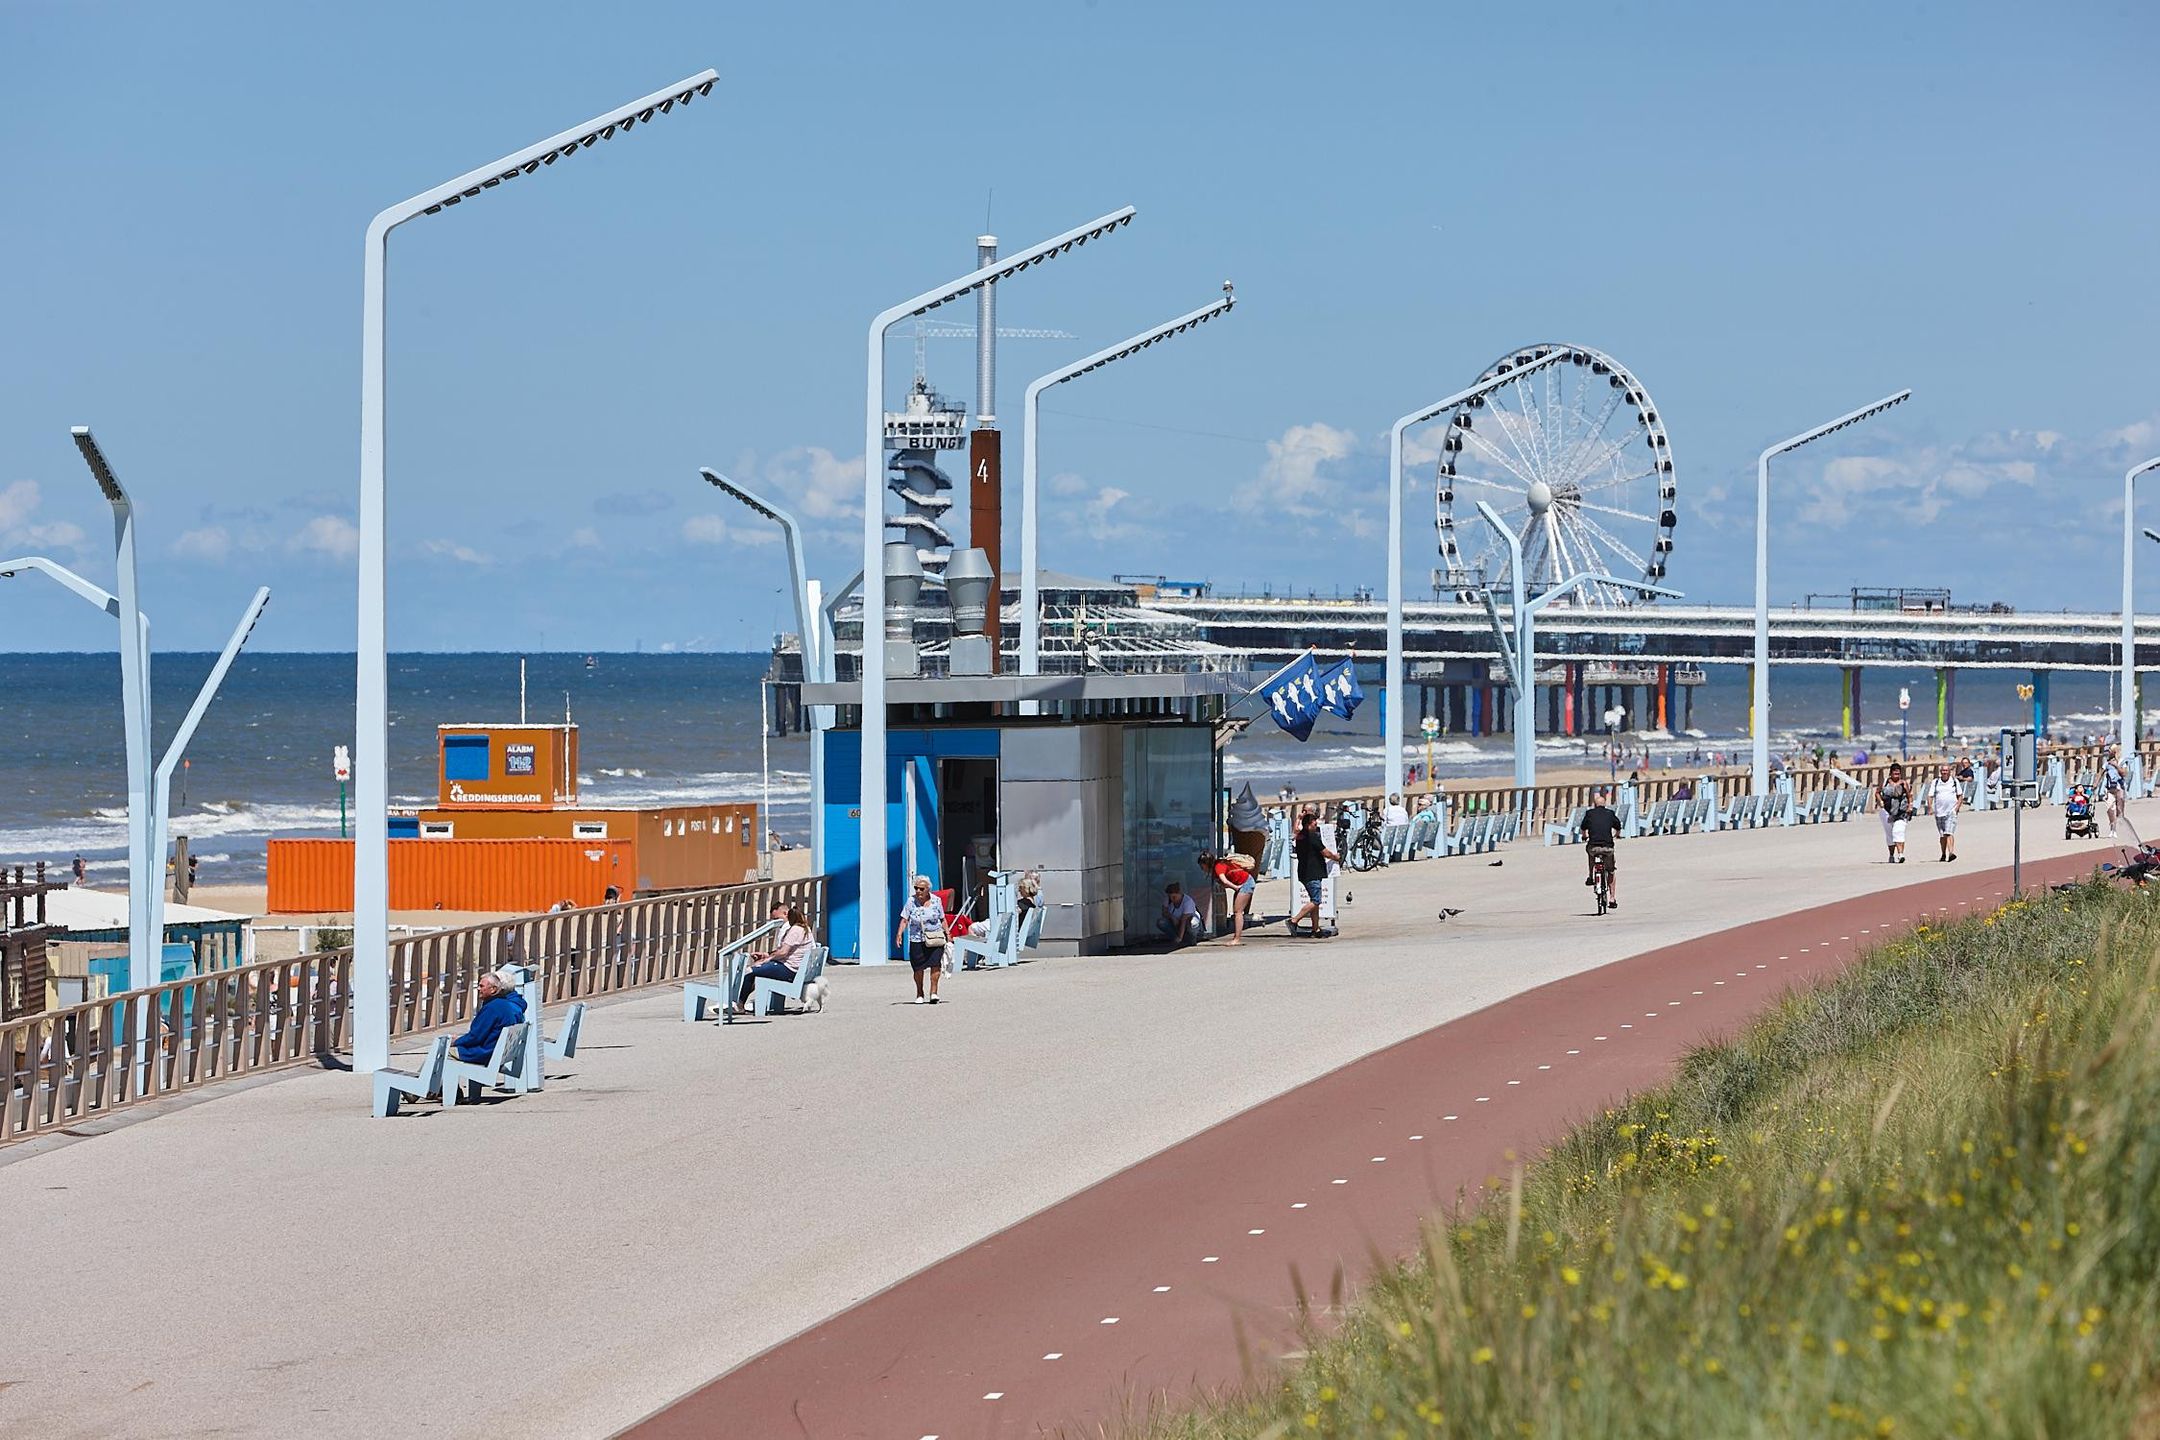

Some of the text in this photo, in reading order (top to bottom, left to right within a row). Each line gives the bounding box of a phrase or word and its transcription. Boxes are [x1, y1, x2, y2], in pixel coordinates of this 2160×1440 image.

[909, 437, 964, 449] BUNGY
[976, 458, 989, 484] 4
[507, 745, 534, 753] ALARM
[456, 793, 542, 803] REDDINGSBRIGADE
